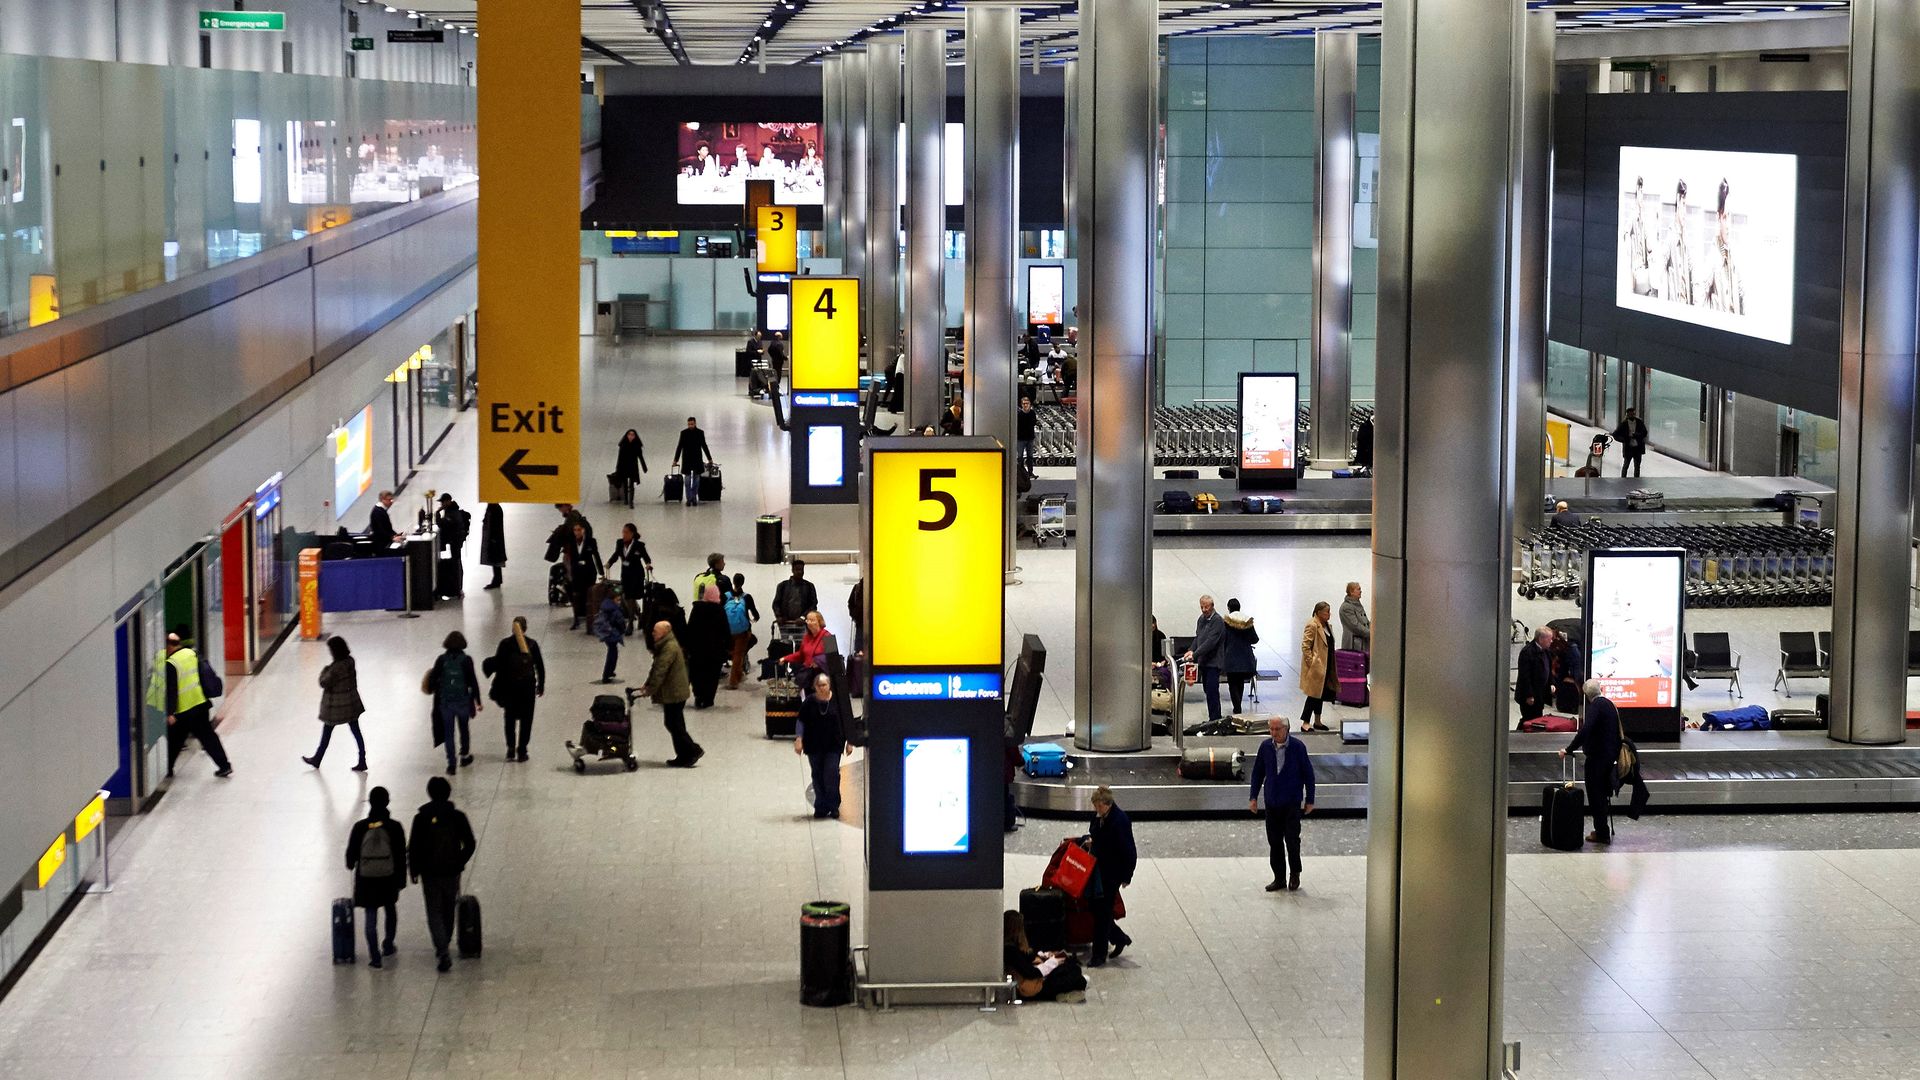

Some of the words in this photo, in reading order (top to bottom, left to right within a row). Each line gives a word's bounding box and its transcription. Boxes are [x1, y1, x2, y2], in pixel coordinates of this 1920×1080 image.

[770, 211, 784, 231] 3
[813, 287, 837, 320] 4
[490, 401, 565, 434] Exit
[918, 468, 958, 532] 5
[878, 680, 943, 696] Customs
